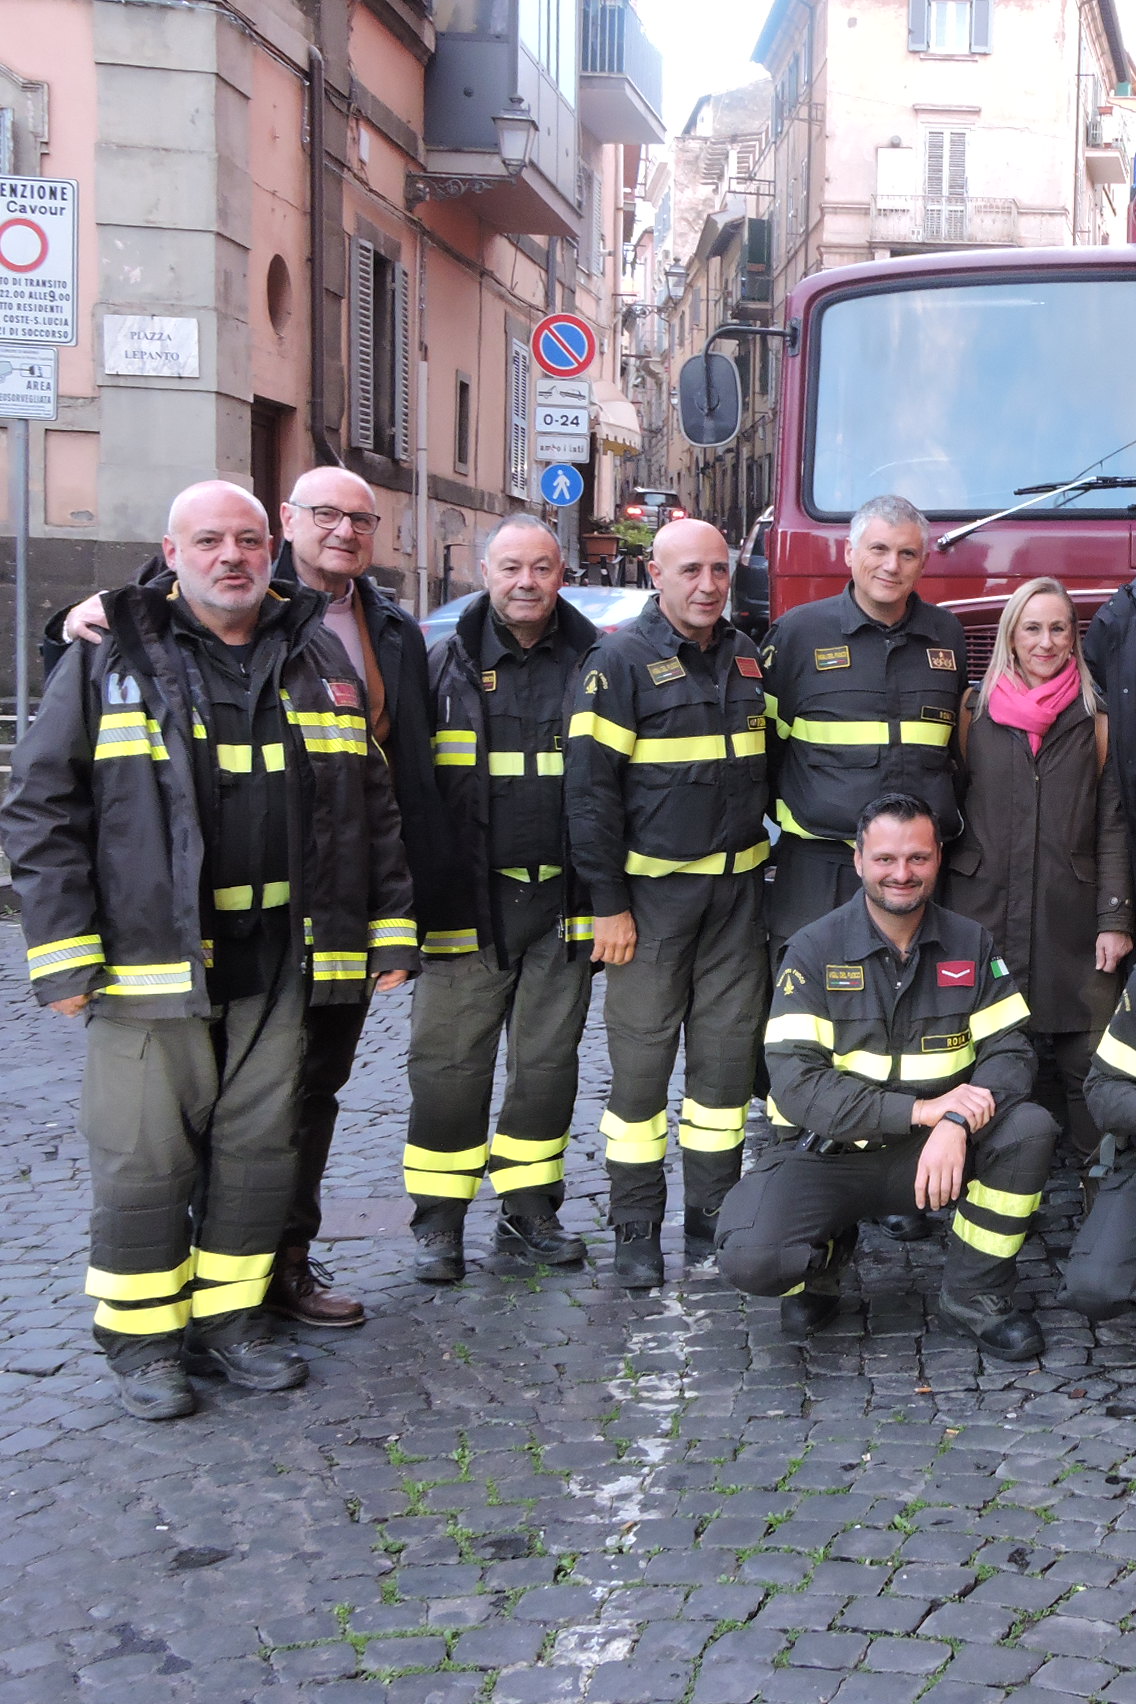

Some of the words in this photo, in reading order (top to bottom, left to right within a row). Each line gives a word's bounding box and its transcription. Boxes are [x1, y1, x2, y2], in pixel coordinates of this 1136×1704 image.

[0, 183, 68, 201] ENZIONE
[7, 200, 66, 216] Cavour
[12, 278, 22, 286] DI
[25, 278, 67, 289] TRANSITO
[0, 290, 25, 299] 22.00
[17, 303, 63, 313] RESIDENTI
[9, 327, 18, 336] DI
[22, 328, 69, 339] SOCCORSO
[130, 331, 172, 341] PIAZZA
[125, 350, 180, 361] LEPANTO
[26, 380, 52, 391] AREA
[543, 413, 580, 427] 0-24
